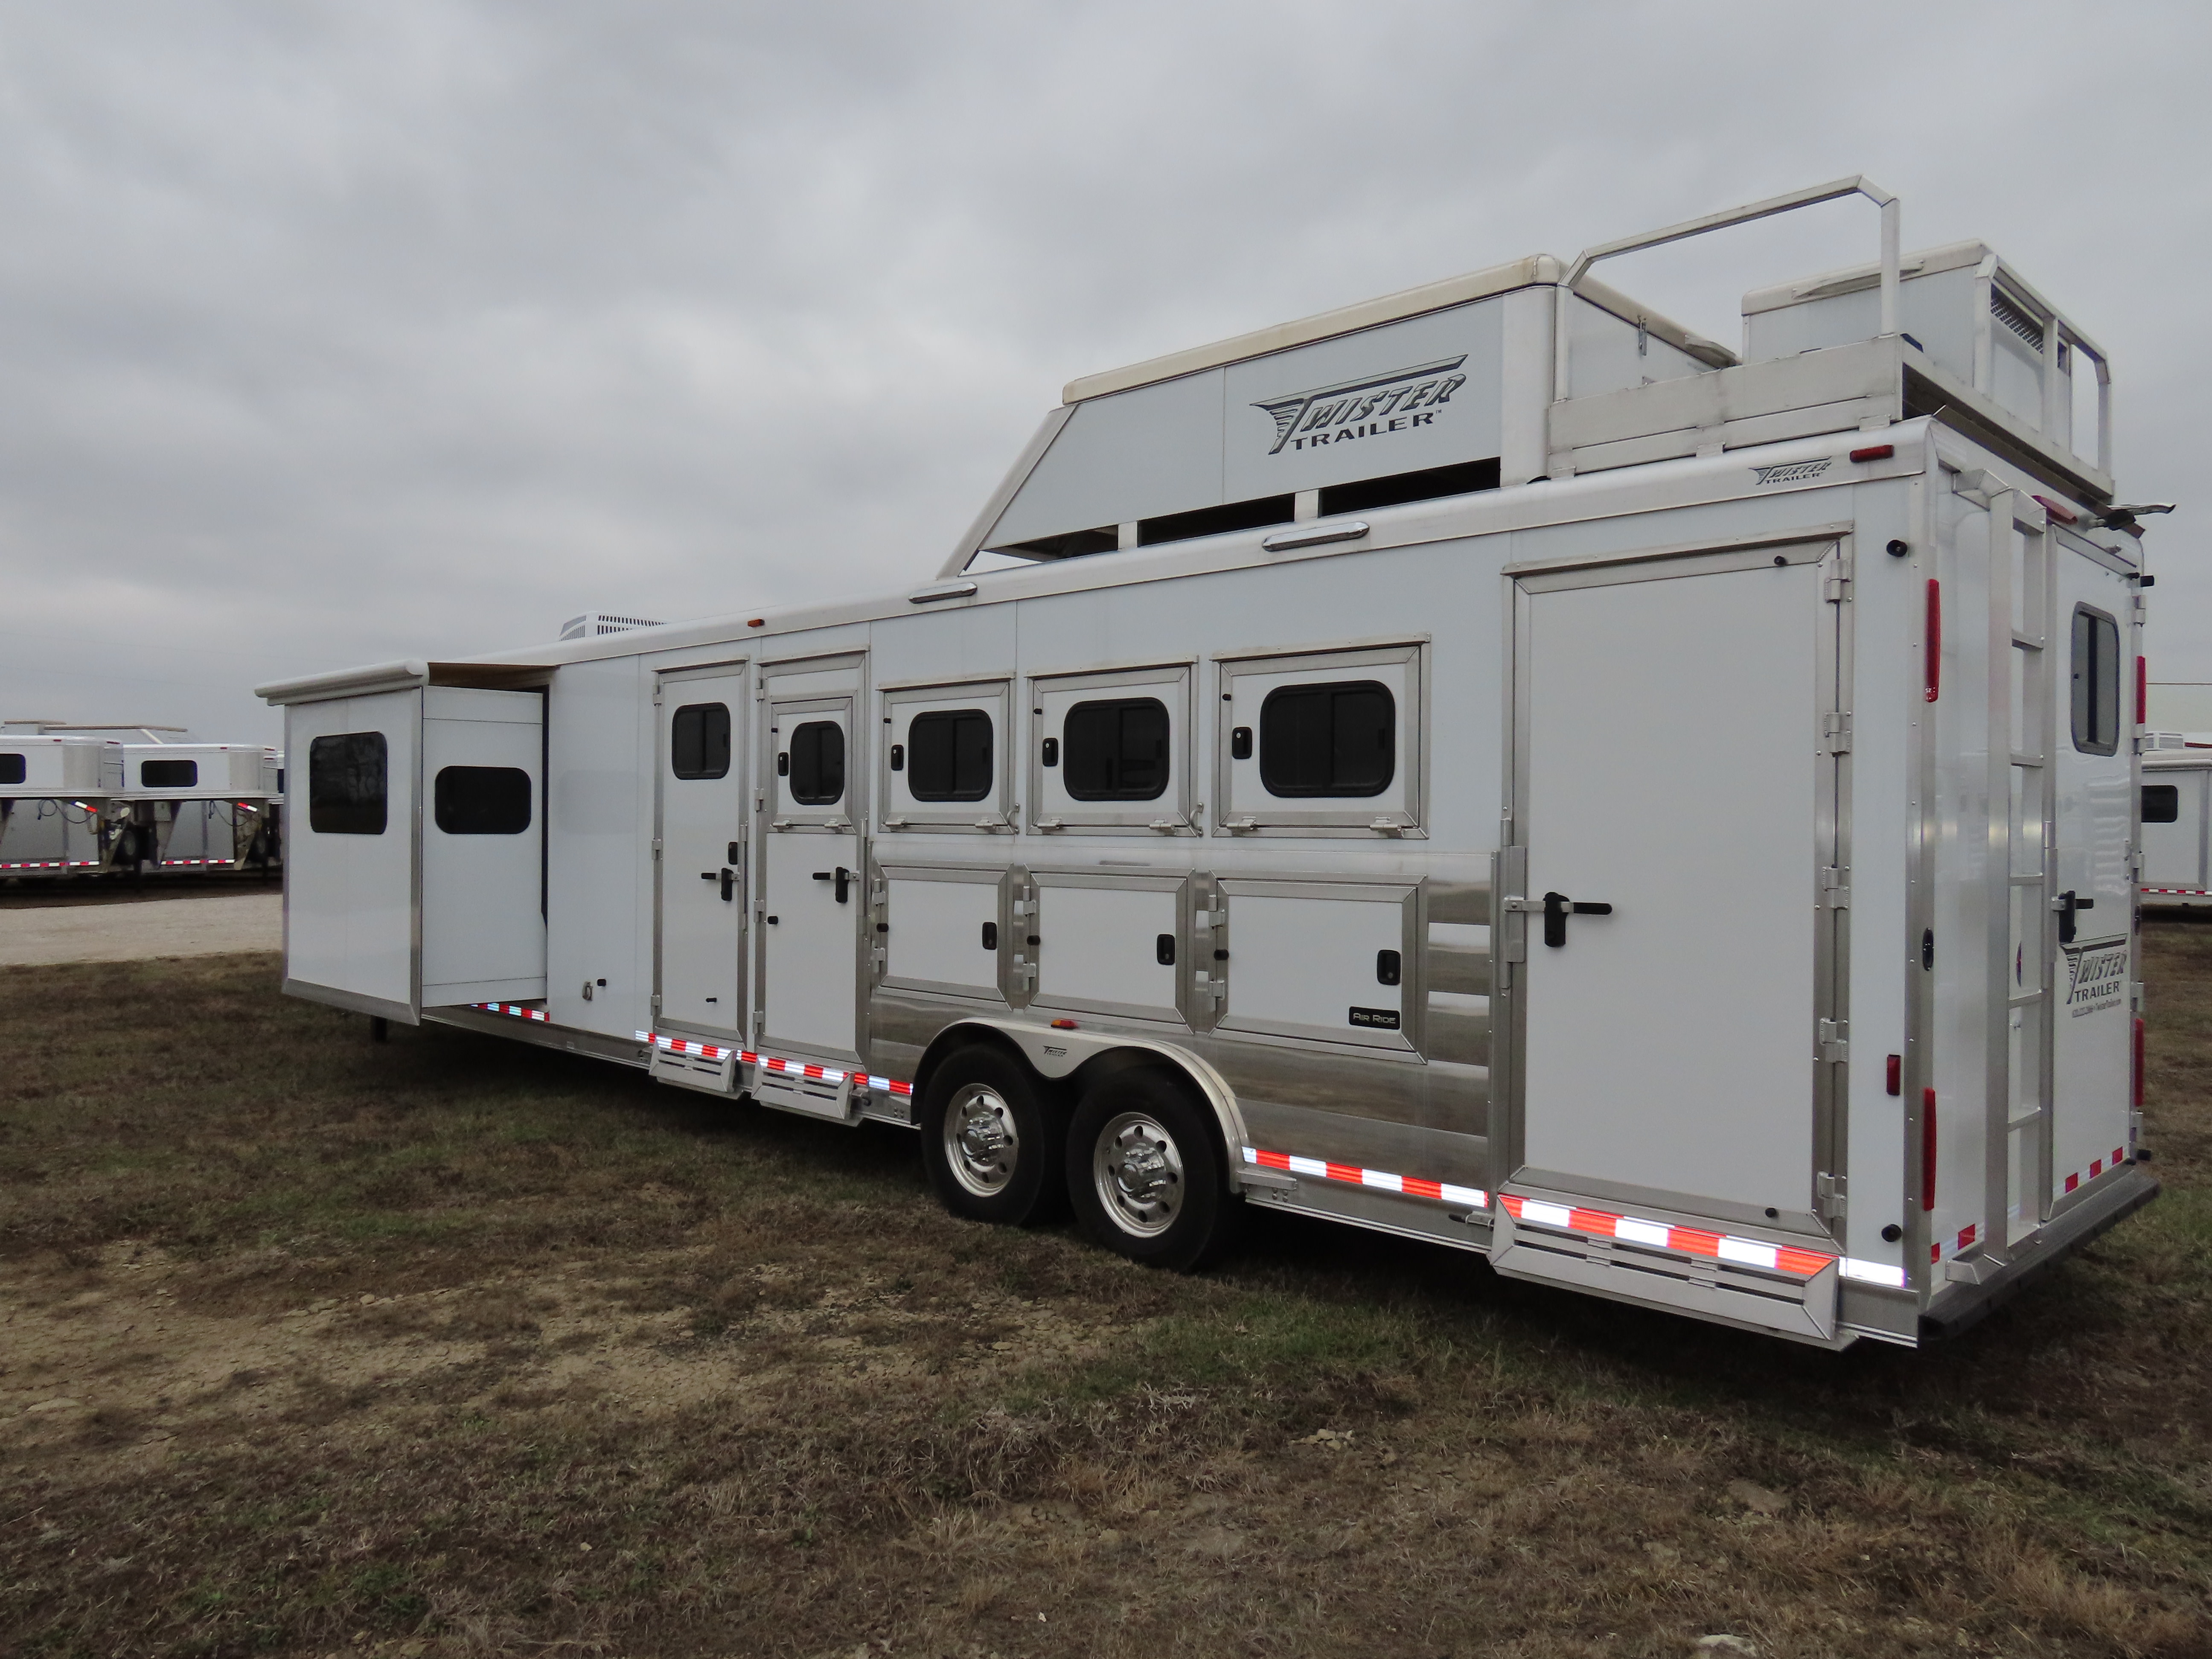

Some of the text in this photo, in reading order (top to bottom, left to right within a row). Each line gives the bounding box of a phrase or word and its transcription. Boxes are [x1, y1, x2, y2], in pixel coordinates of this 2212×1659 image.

[1249, 353, 1468, 455] TWISTER
[1291, 412, 1433, 451] TRAILER
[1748, 455, 1833, 485] TWISTER
[1765, 472, 1820, 484] TRAILER
[2059, 933, 2128, 1004] TWISTER
[2075, 981, 2120, 1003] TRAILER
[1353, 1013, 1396, 1024] AIR RIDE
